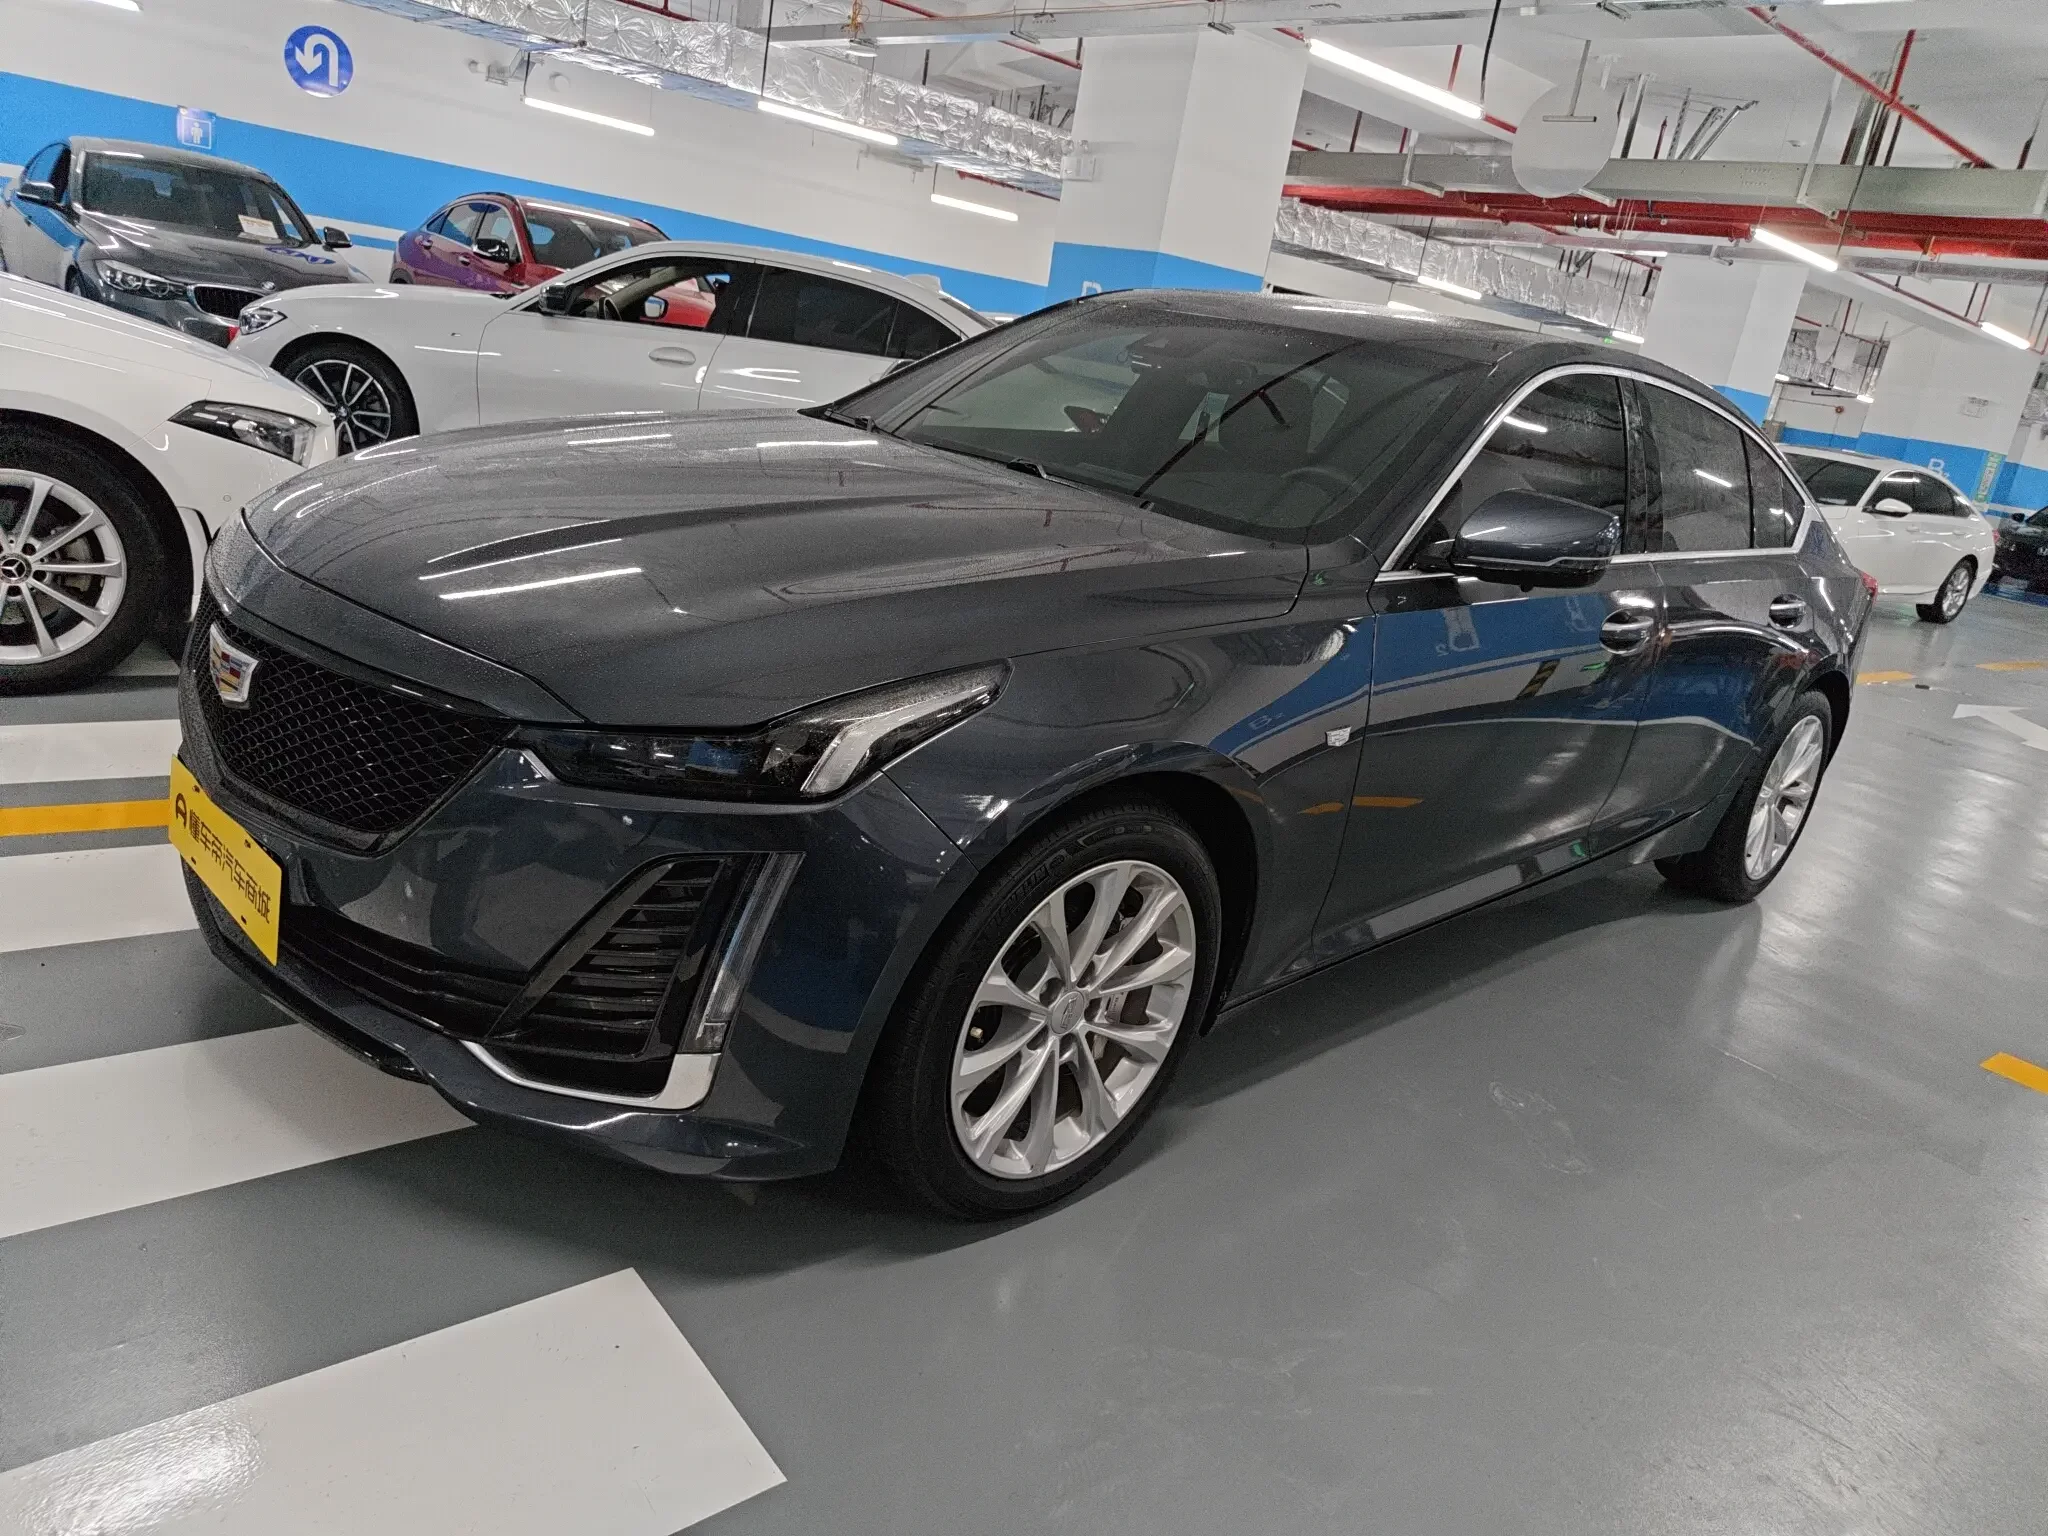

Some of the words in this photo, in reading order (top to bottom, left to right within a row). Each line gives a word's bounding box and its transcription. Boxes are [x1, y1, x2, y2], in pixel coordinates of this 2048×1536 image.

[189, 808, 271, 924] 懂车帝汽车商城
